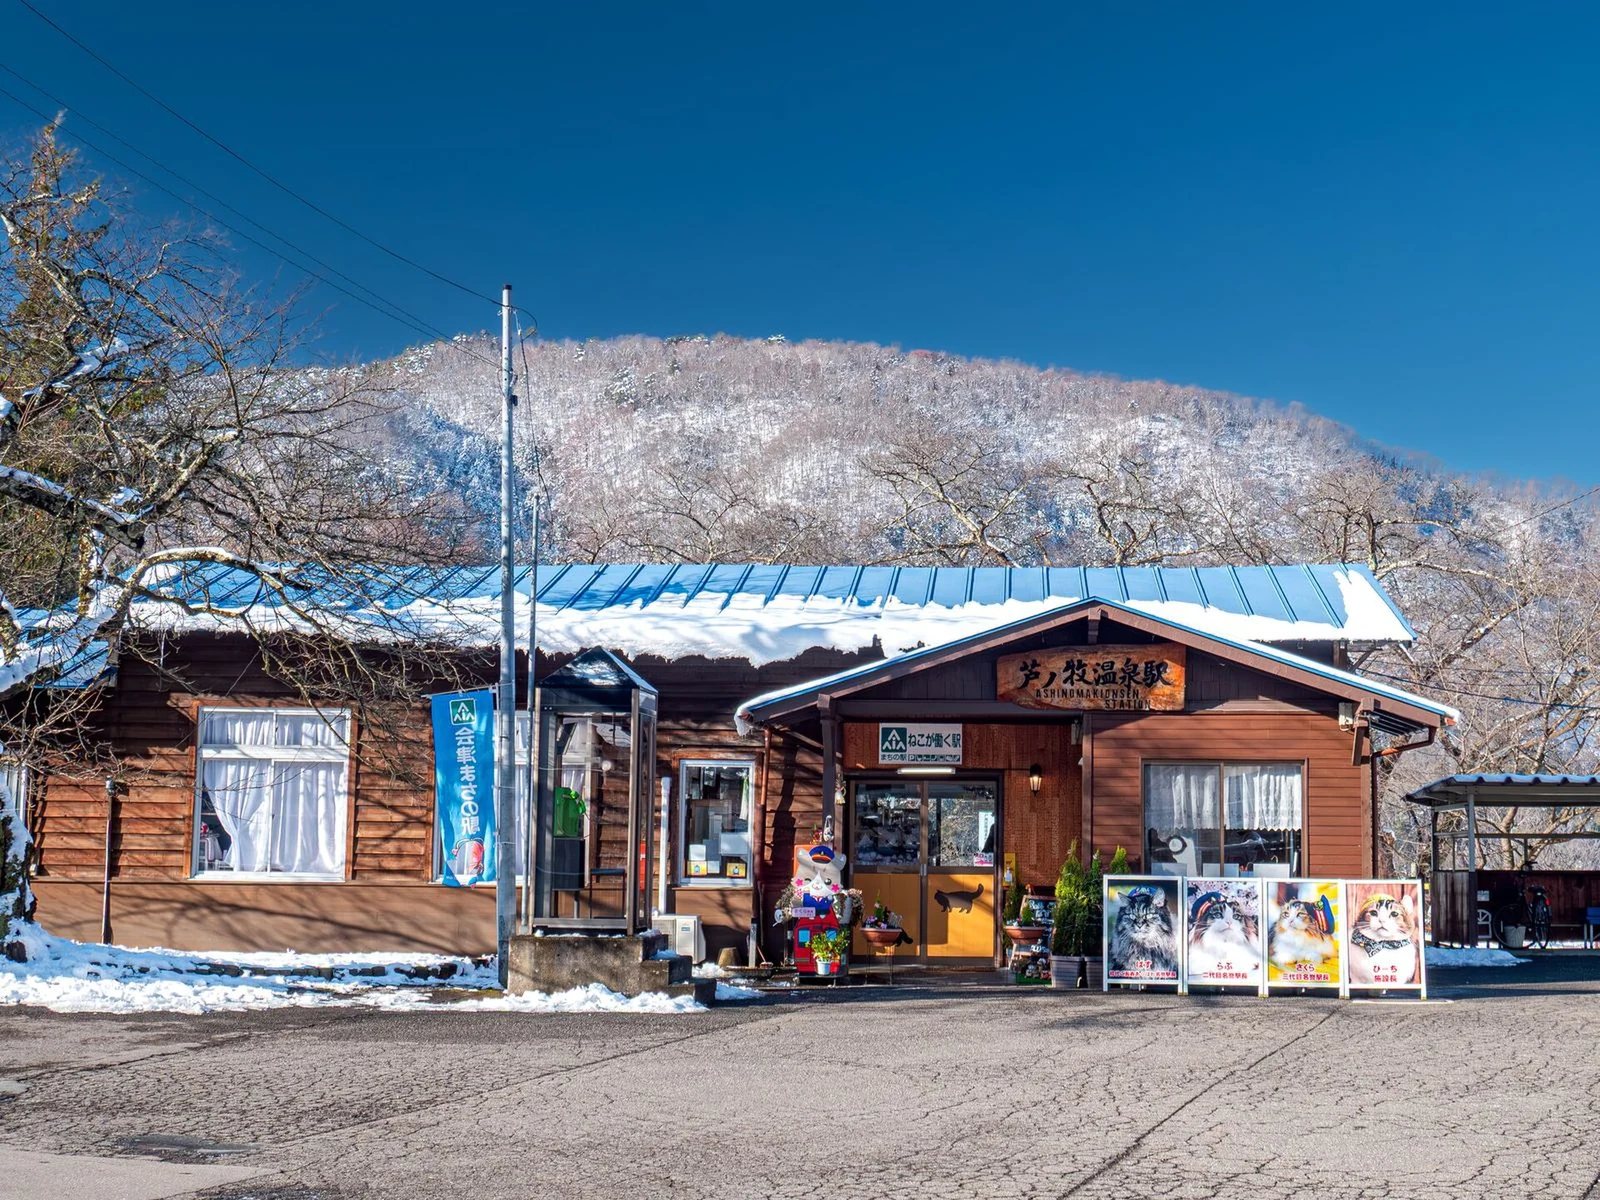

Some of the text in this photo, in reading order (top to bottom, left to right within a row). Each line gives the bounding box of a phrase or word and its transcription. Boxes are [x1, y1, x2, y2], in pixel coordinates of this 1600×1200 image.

[1018, 658, 1172, 690] 芦ノ牧温泉駅
[1036, 689, 1140, 700] ASHINOMAKIONSEN
[1105, 700, 1150, 710] STATION
[908, 733, 961, 748] ねこが働く駅
[1217, 962, 1232, 970] らぶ
